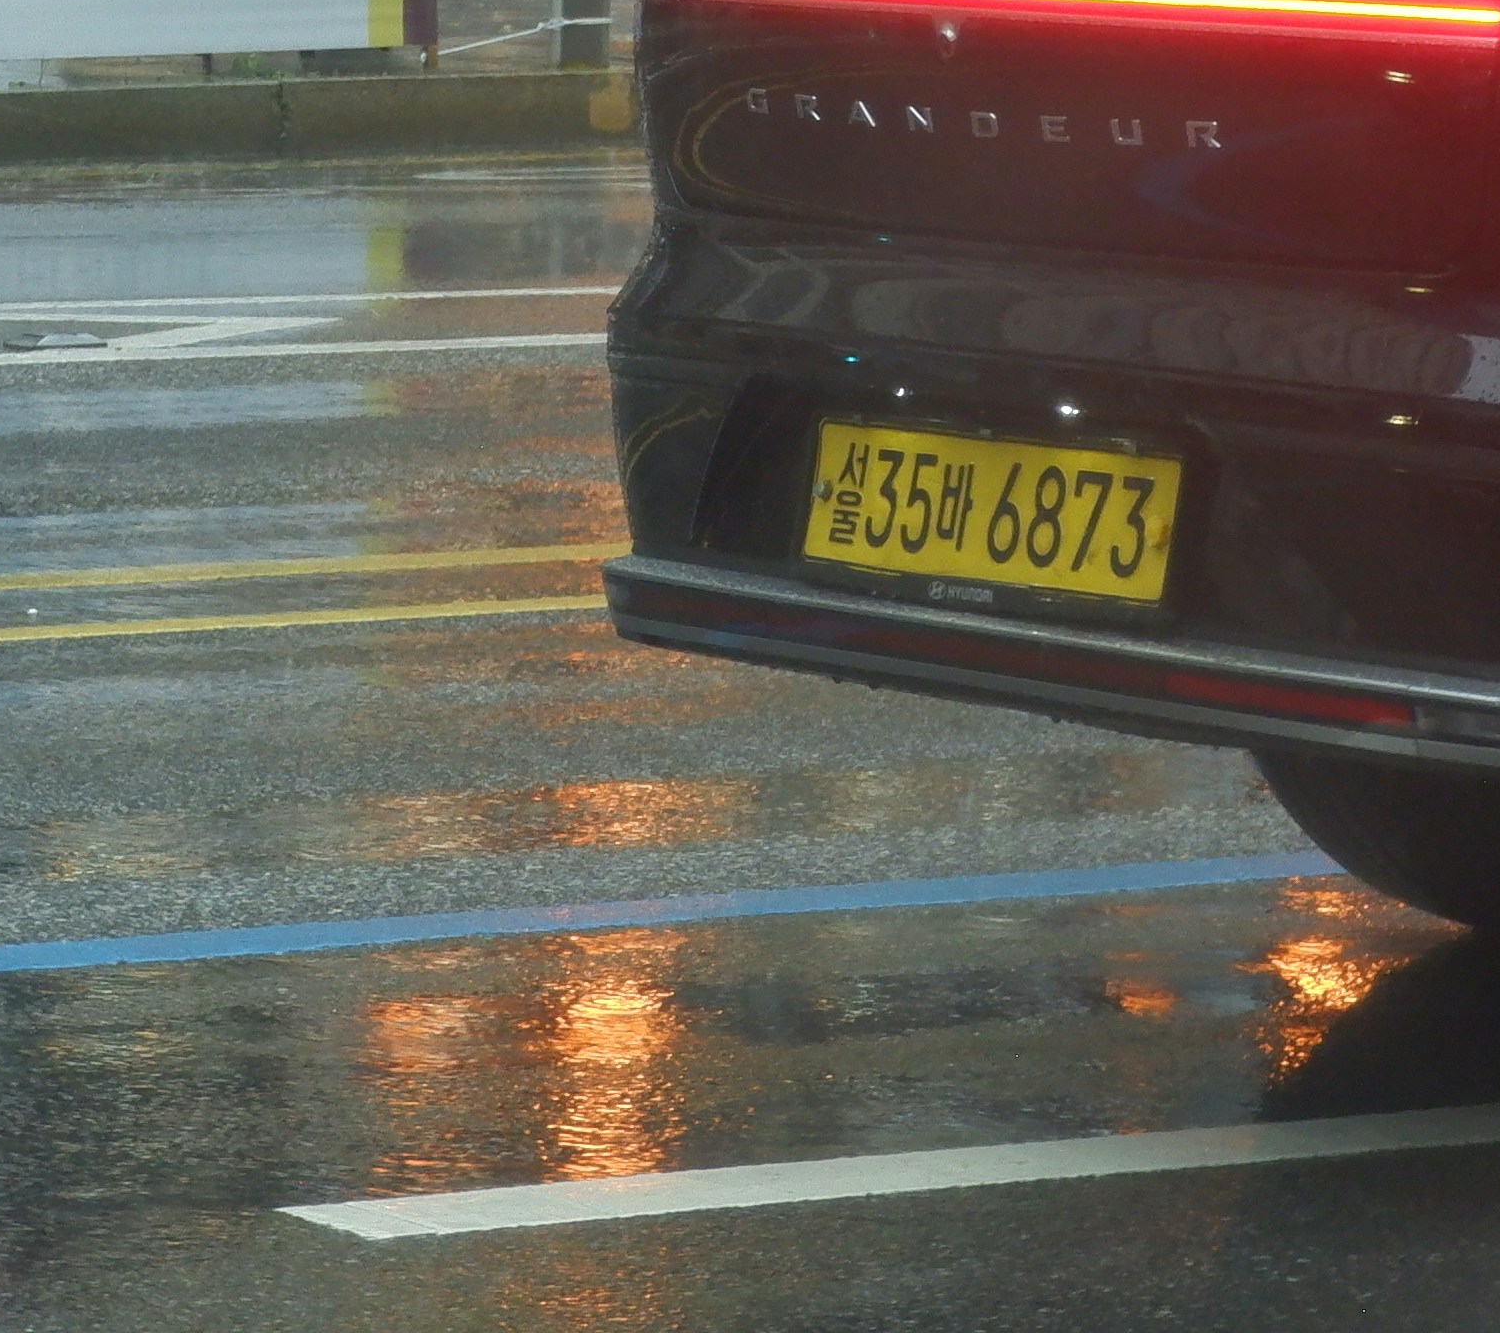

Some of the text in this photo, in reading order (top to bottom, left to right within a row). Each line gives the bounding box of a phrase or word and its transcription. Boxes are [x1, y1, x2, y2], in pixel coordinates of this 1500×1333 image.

[746, 87, 1224, 150] GRANDEUR
[827, 441, 1157, 580] 서울 35바 6873
